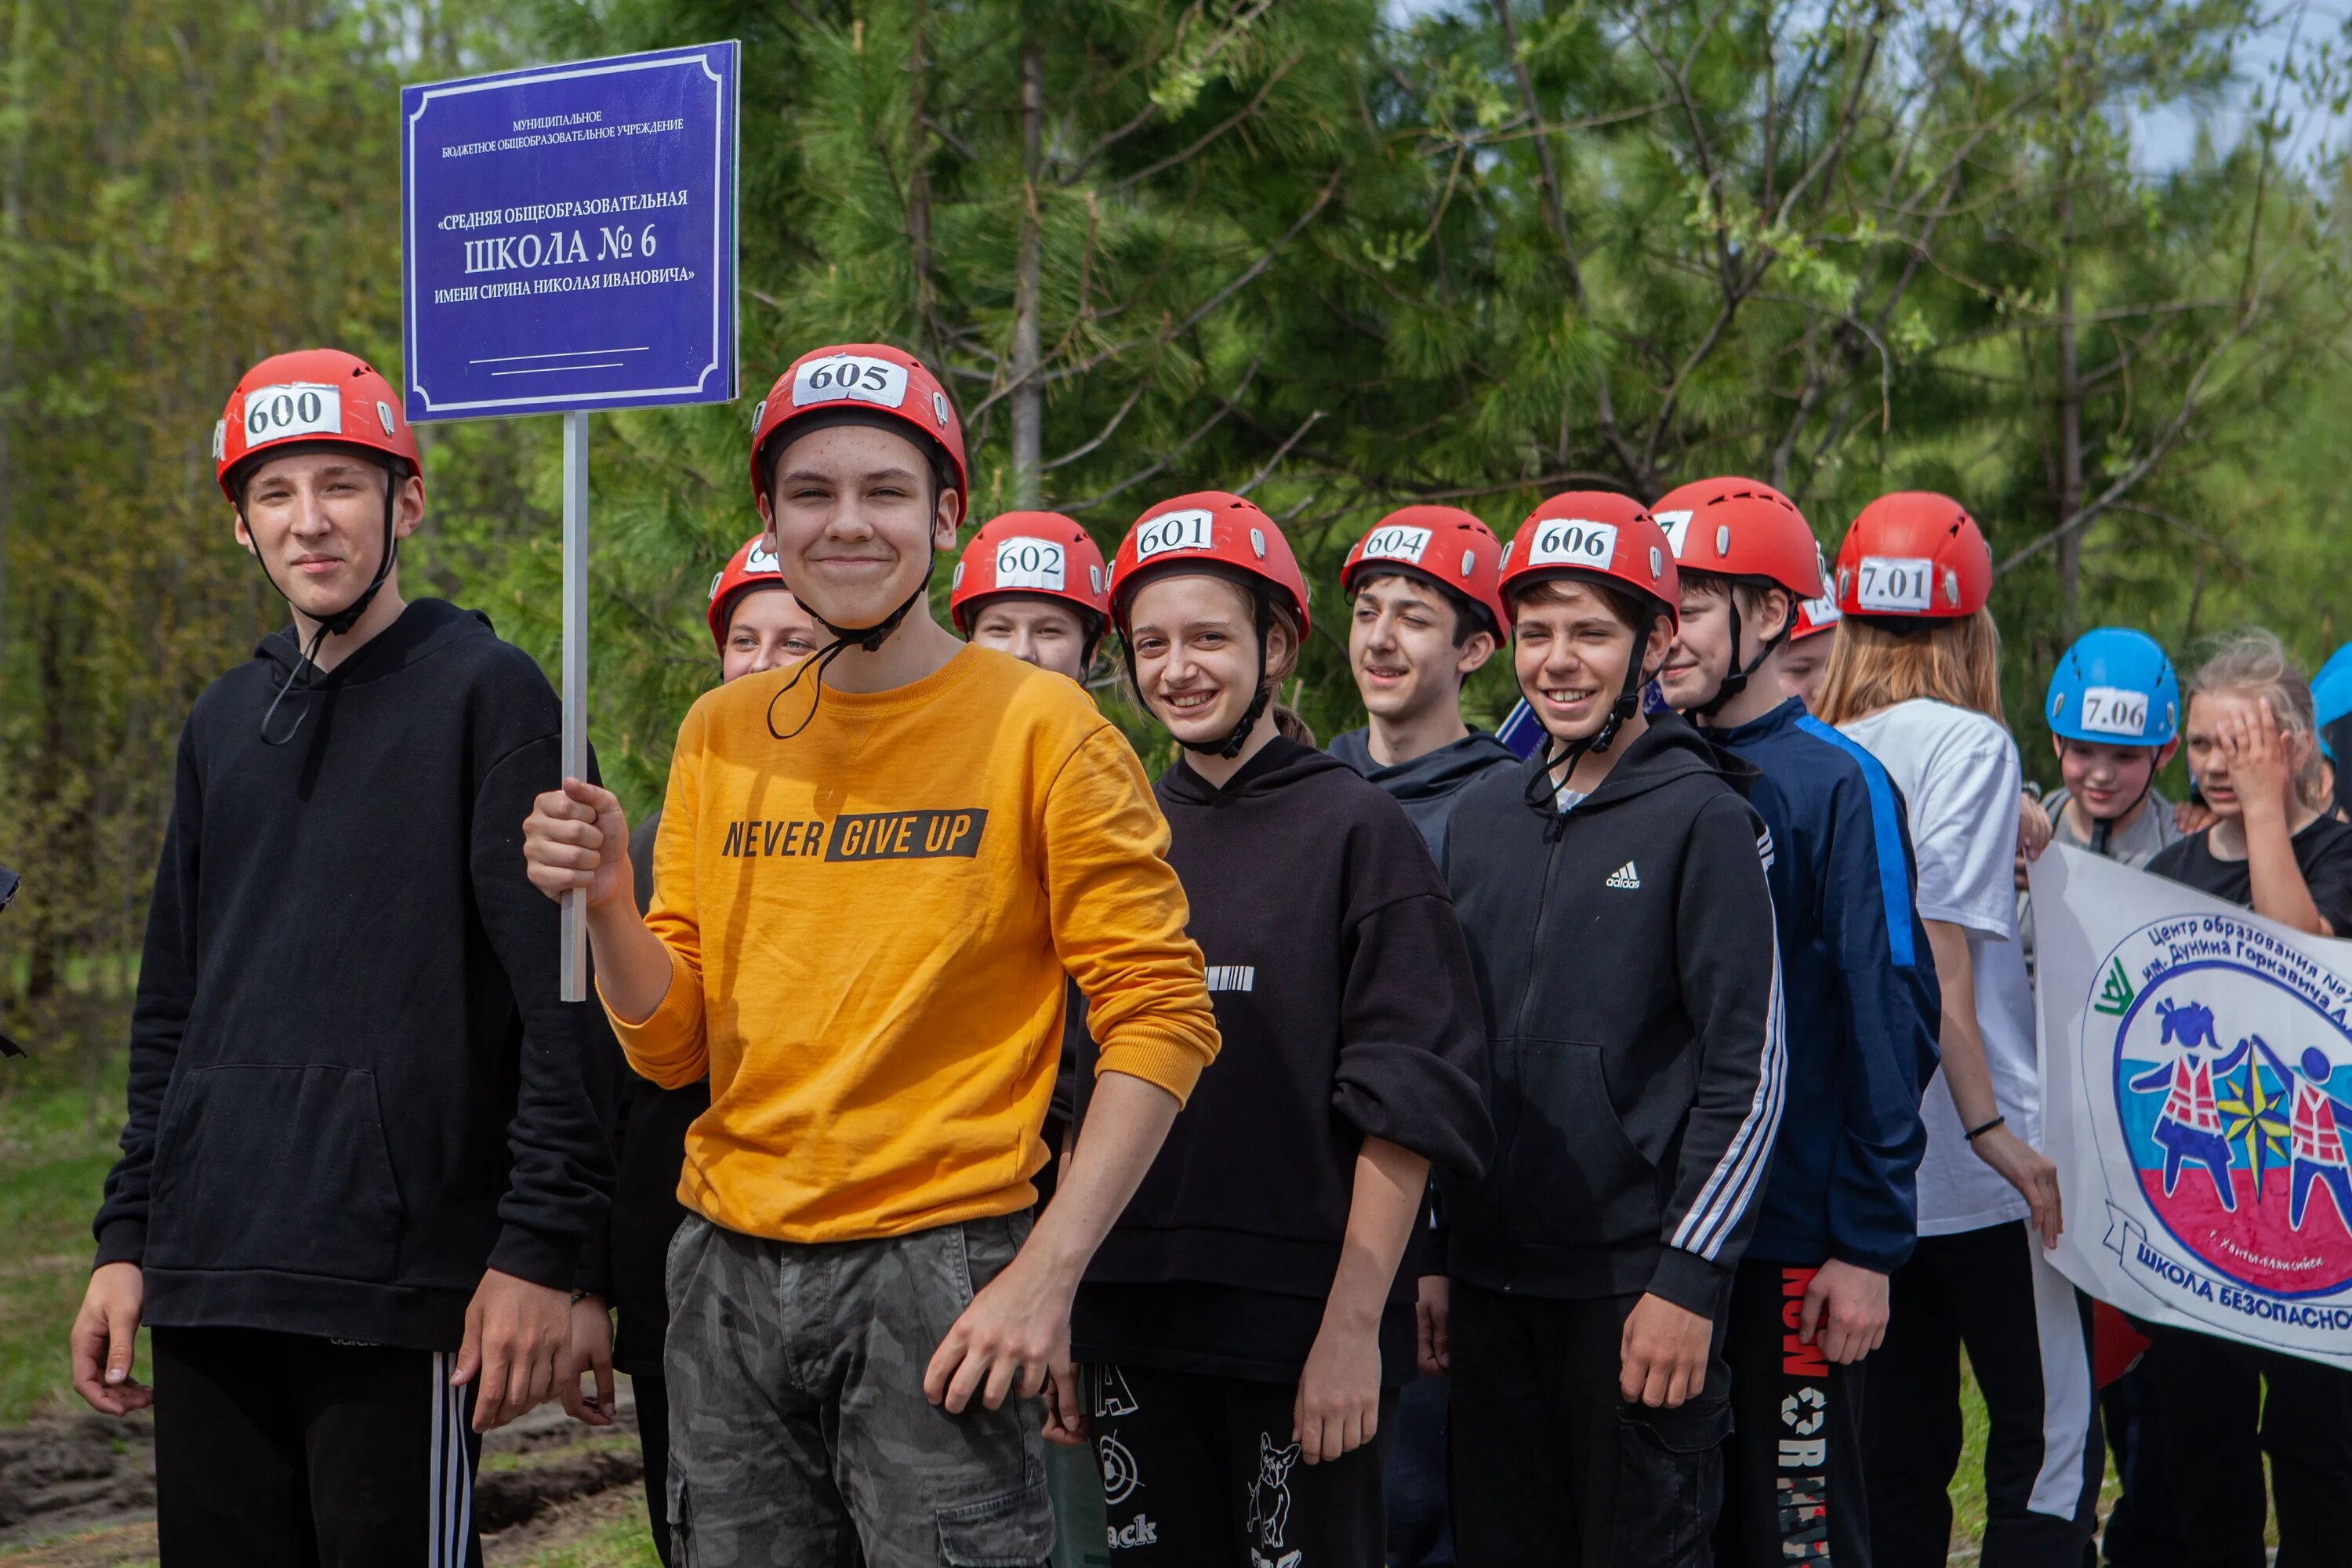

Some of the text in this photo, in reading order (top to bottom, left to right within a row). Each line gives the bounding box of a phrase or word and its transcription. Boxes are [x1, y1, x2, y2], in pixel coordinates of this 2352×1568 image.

[441, 118, 684, 158] БЮДЖЕТНОЕ ОБЩЕОБРАЗОВАТЕЛЬНОЕ УЧРЕЖДЕНИЕ
[513, 111, 602, 132] МУНИЦИПАЛЬНОЕ
[437, 190, 688, 233] «СРЕДНЯЯ ОБЩЕОБРАЗОВАТЕЛЬНАЯ
[464, 224, 657, 274] ШКОЛА № 6
[434, 267, 695, 304] ИМЕНИ СИРИНА НИКОЛАЯ ИВАНОВИЧА»
[809, 363, 889, 390] 605
[249, 391, 322, 434] 600
[1138, 521, 1207, 554] 601
[1367, 528, 1424, 555] 604
[1541, 527, 1608, 556] 606
[997, 545, 1062, 576] 602
[1862, 568, 1926, 599] 7.01
[2086, 697, 2147, 730] 7.06
[721, 815, 971, 858] NEVER GIVE UP
[1606, 877, 1641, 889] adidas
[2147, 919, 2198, 947] Центр
[2202, 915, 2318, 979] образования
[2142, 957, 2168, 982] им.
[2235, 942, 2330, 1010] Горкавича
[2136, 1243, 2352, 1331] ШКОЛА БЕЗОПАСНО
